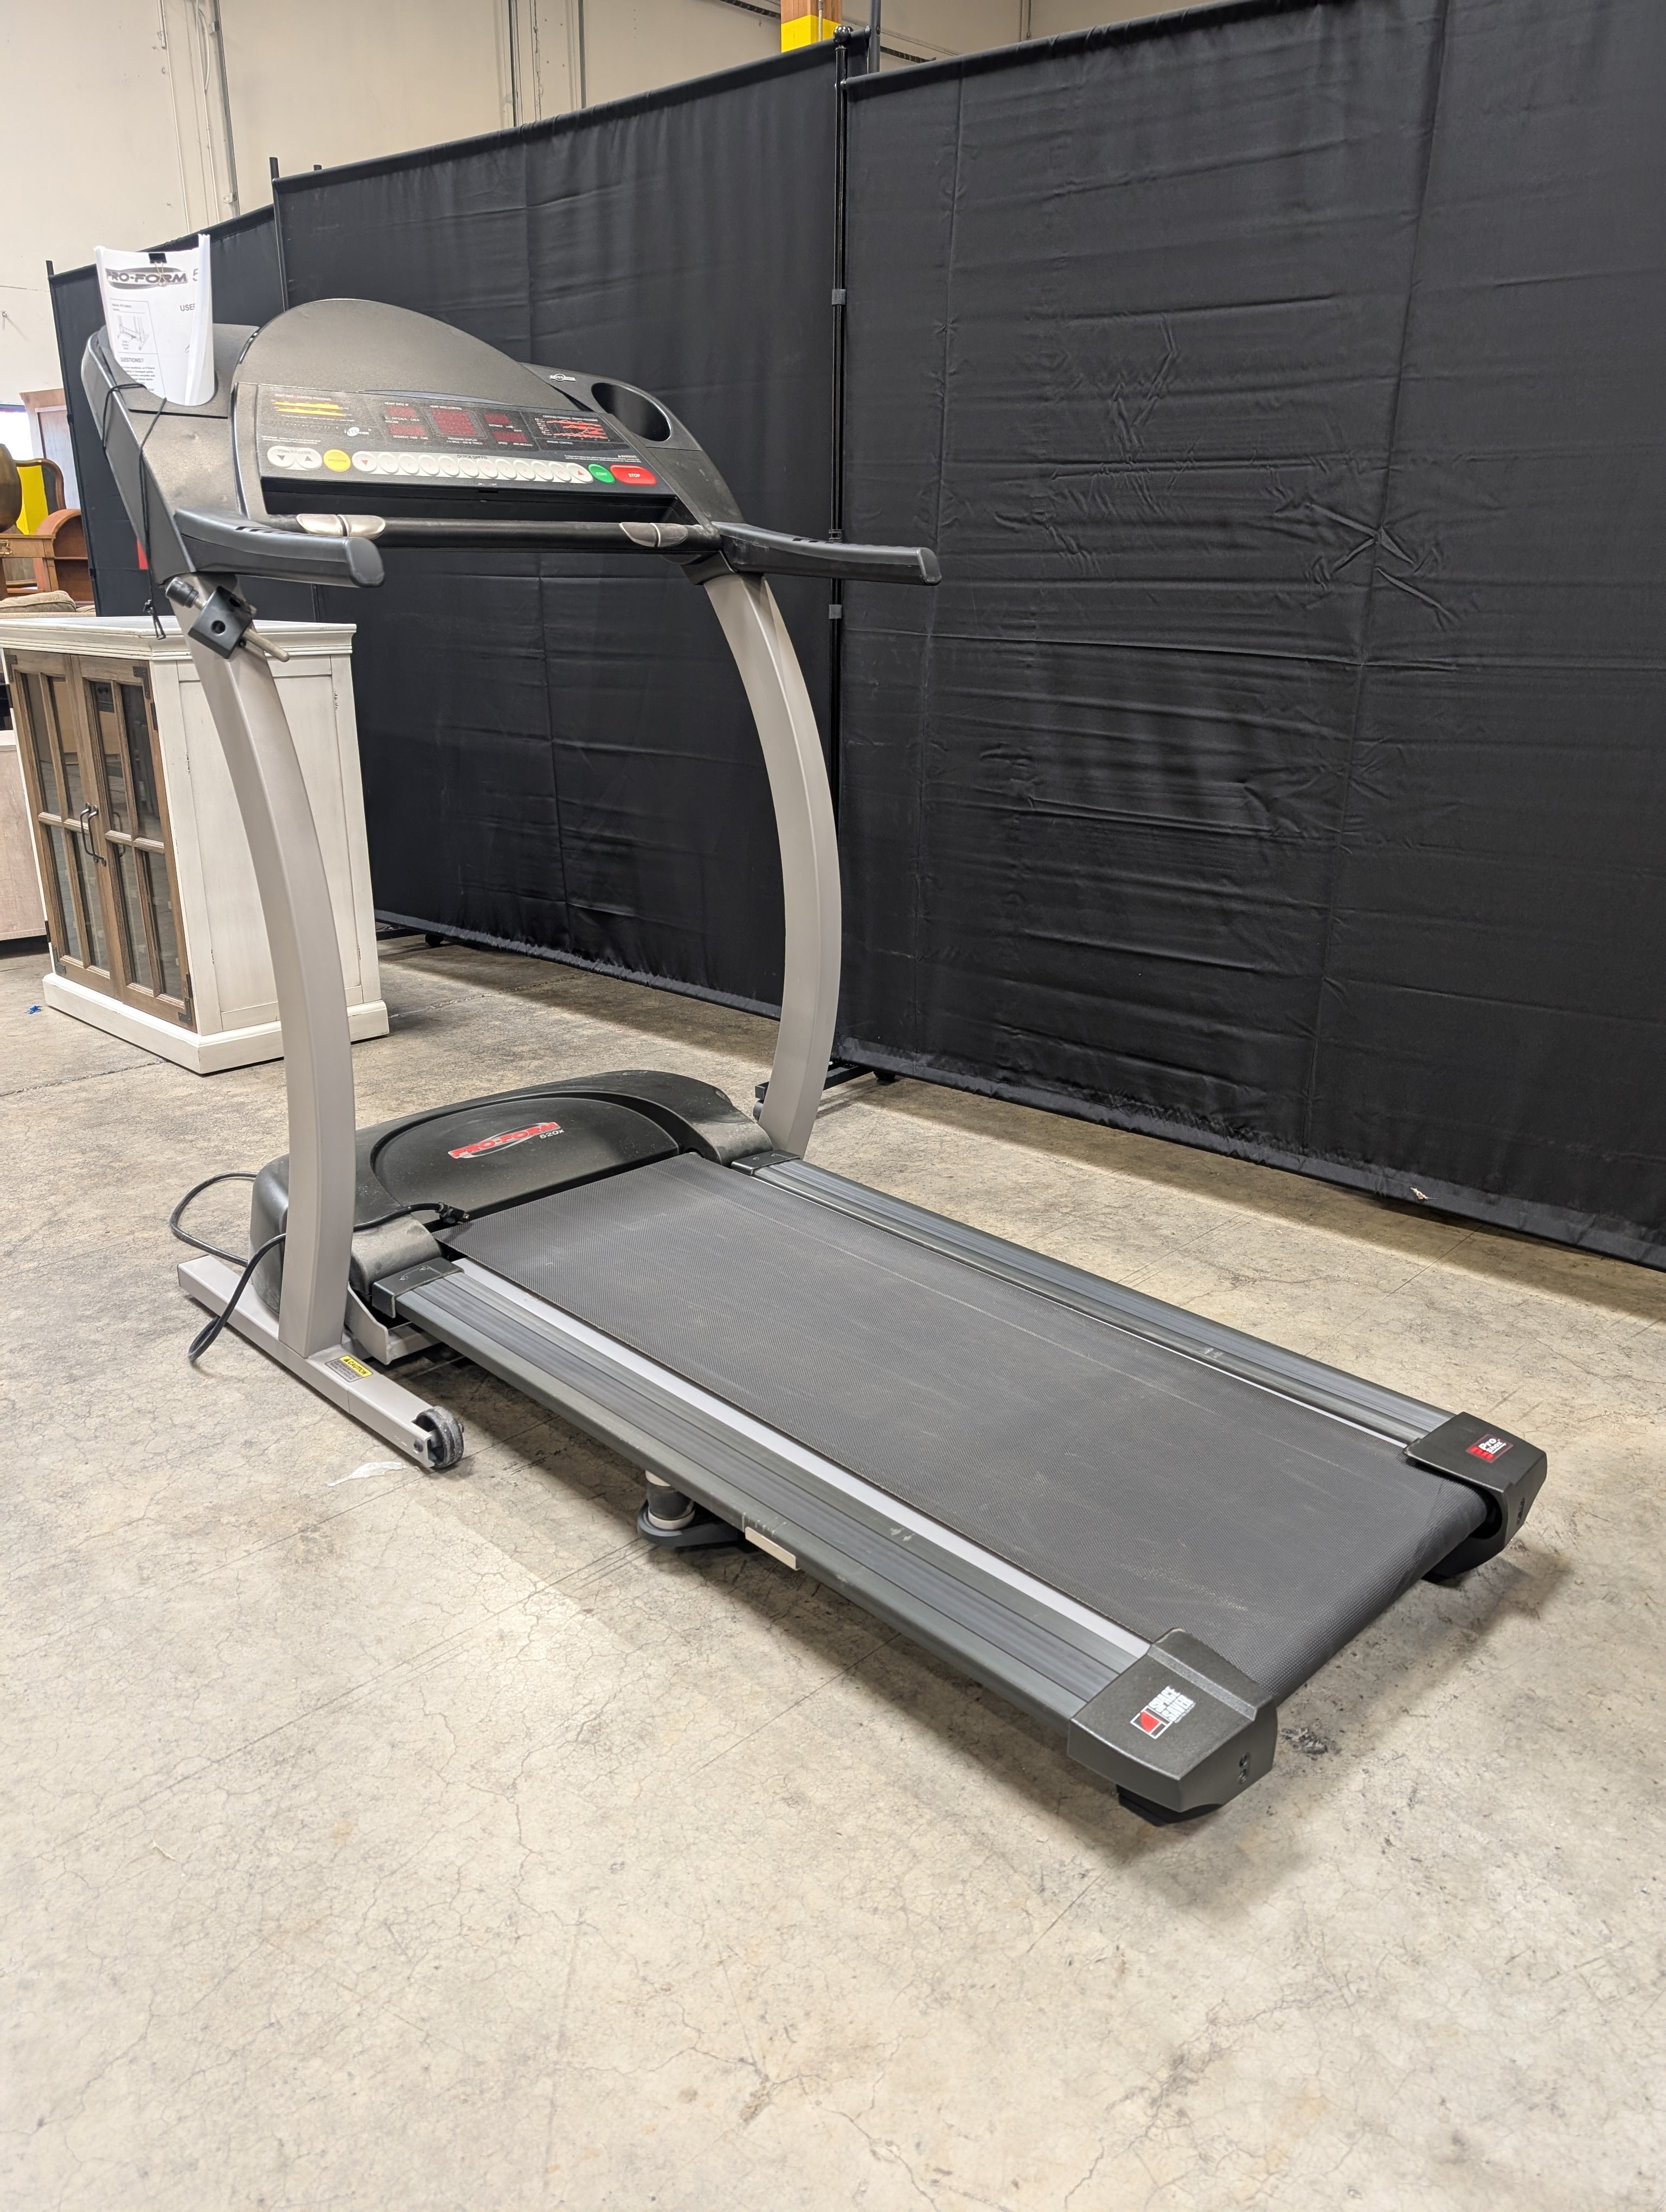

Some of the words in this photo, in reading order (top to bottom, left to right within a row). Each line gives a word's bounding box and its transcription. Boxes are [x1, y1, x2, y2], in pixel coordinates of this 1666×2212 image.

[347, 1361, 368, 1375] CAUTION
[1478, 1438, 1497, 1451] Pro
[1148, 1686, 1181, 1713] SPACE
[1161, 1695, 1194, 1722] SAVER
